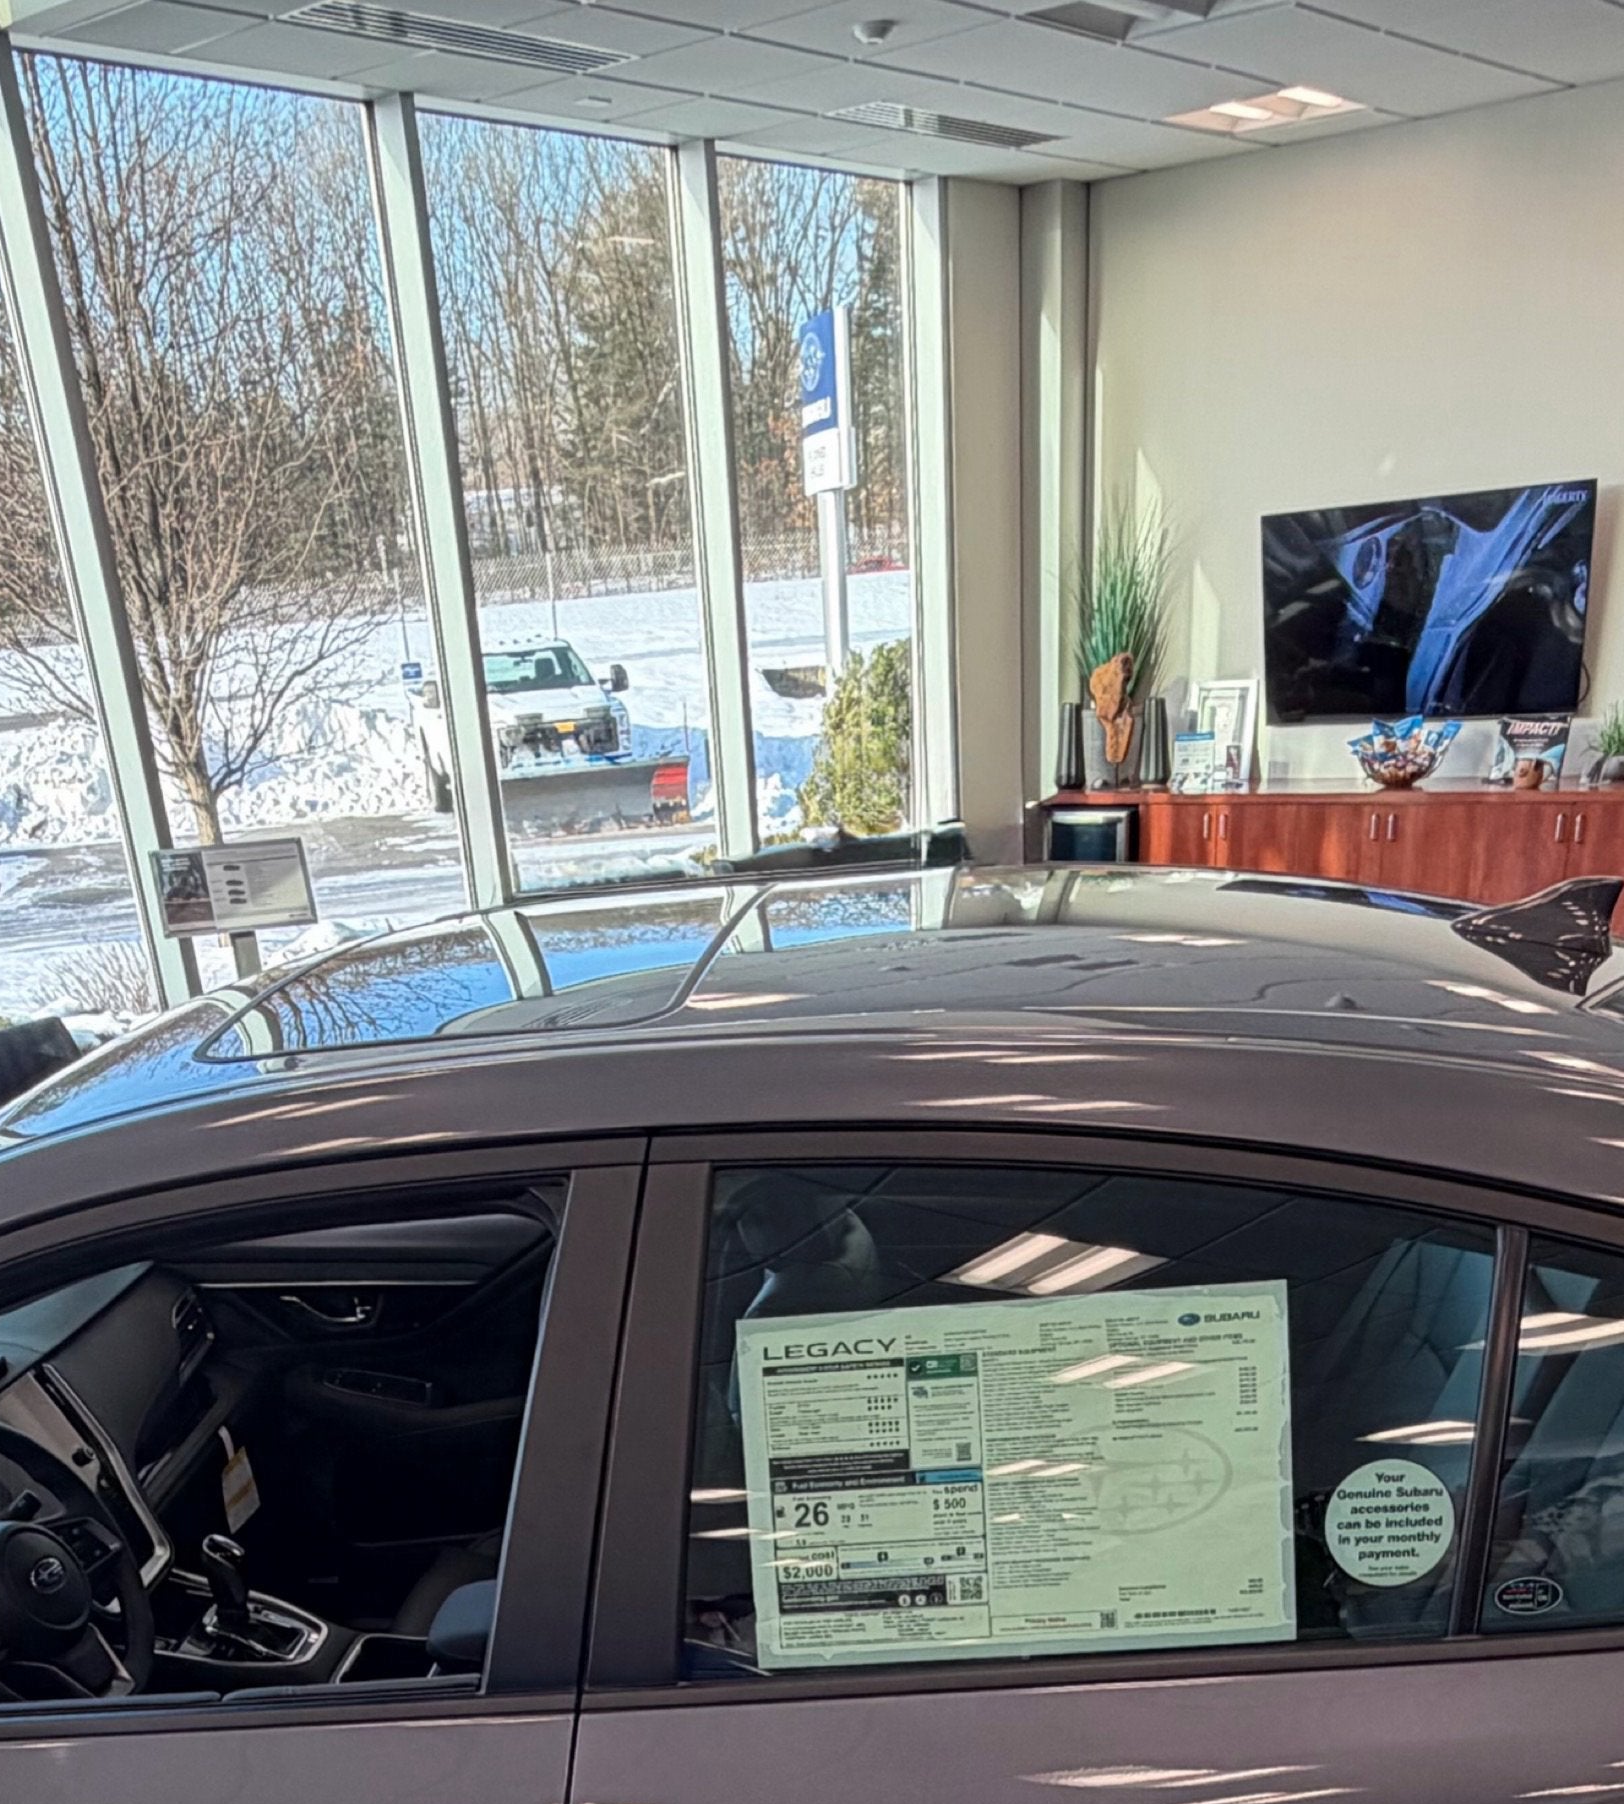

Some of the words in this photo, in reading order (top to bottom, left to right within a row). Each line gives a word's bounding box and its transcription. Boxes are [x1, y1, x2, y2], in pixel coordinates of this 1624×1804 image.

[1203, 1310, 1260, 1323] SUBARU
[763, 1338, 897, 1361] LEGACY
[1375, 1472, 1406, 1483] Your
[1336, 1488, 1392, 1500] Genuine
[1396, 1486, 1444, 1498] Subaru
[944, 1497, 966, 1510] 500
[1350, 1502, 1430, 1514] accessories
[794, 1501, 830, 1528] 26
[1337, 1520, 1361, 1530] can
[1364, 1518, 1382, 1529] be
[1385, 1516, 1443, 1528] included
[1338, 1534, 1351, 1545] in
[1354, 1535, 1384, 1547] your
[1387, 1532, 1442, 1544] monthly
[1358, 1548, 1420, 1561] payment.
